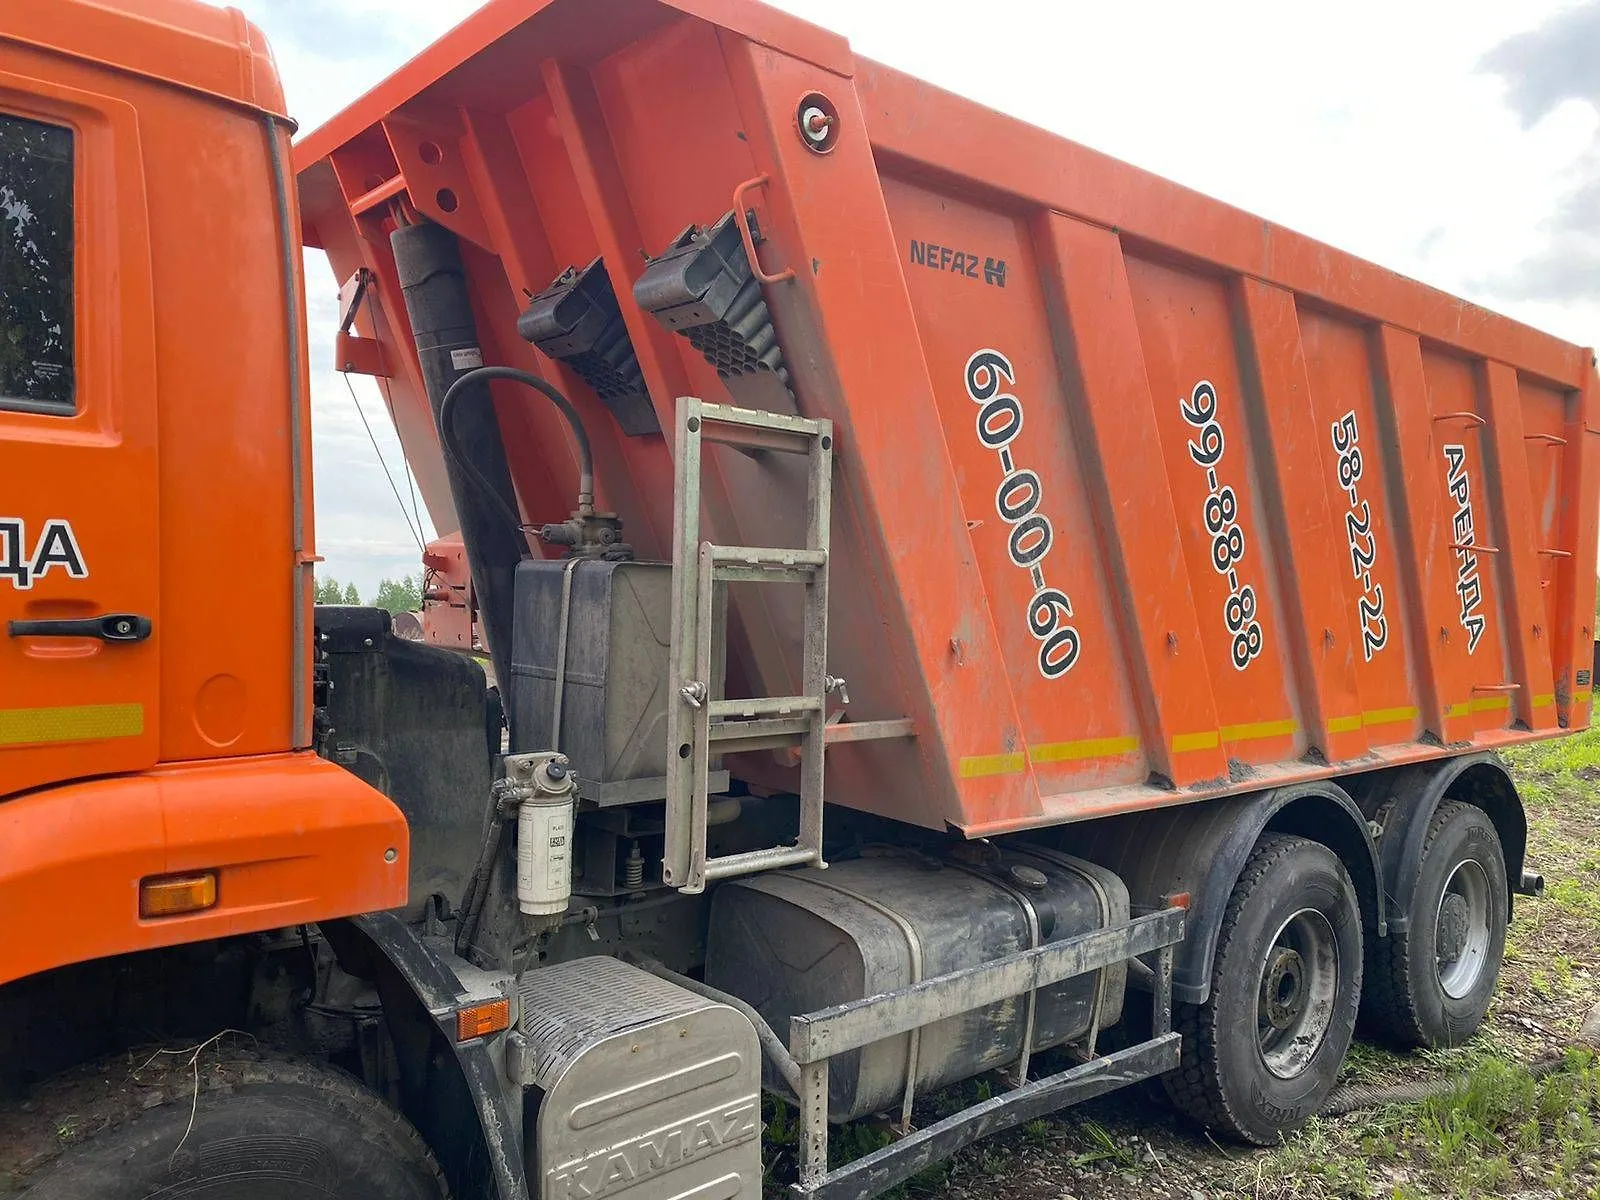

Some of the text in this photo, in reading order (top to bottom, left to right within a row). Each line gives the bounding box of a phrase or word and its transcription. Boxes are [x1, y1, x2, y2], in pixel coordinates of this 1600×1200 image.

[910, 239, 979, 279] NEFAZ
[964, 348, 1081, 679] 60-00-60
[1180, 380, 1263, 670] 99-88-88
[1332, 410, 1388, 662] 58-22-22
[1443, 445, 1486, 656] АРЕНДА
[554, 1103, 756, 1200] KAMAZ
